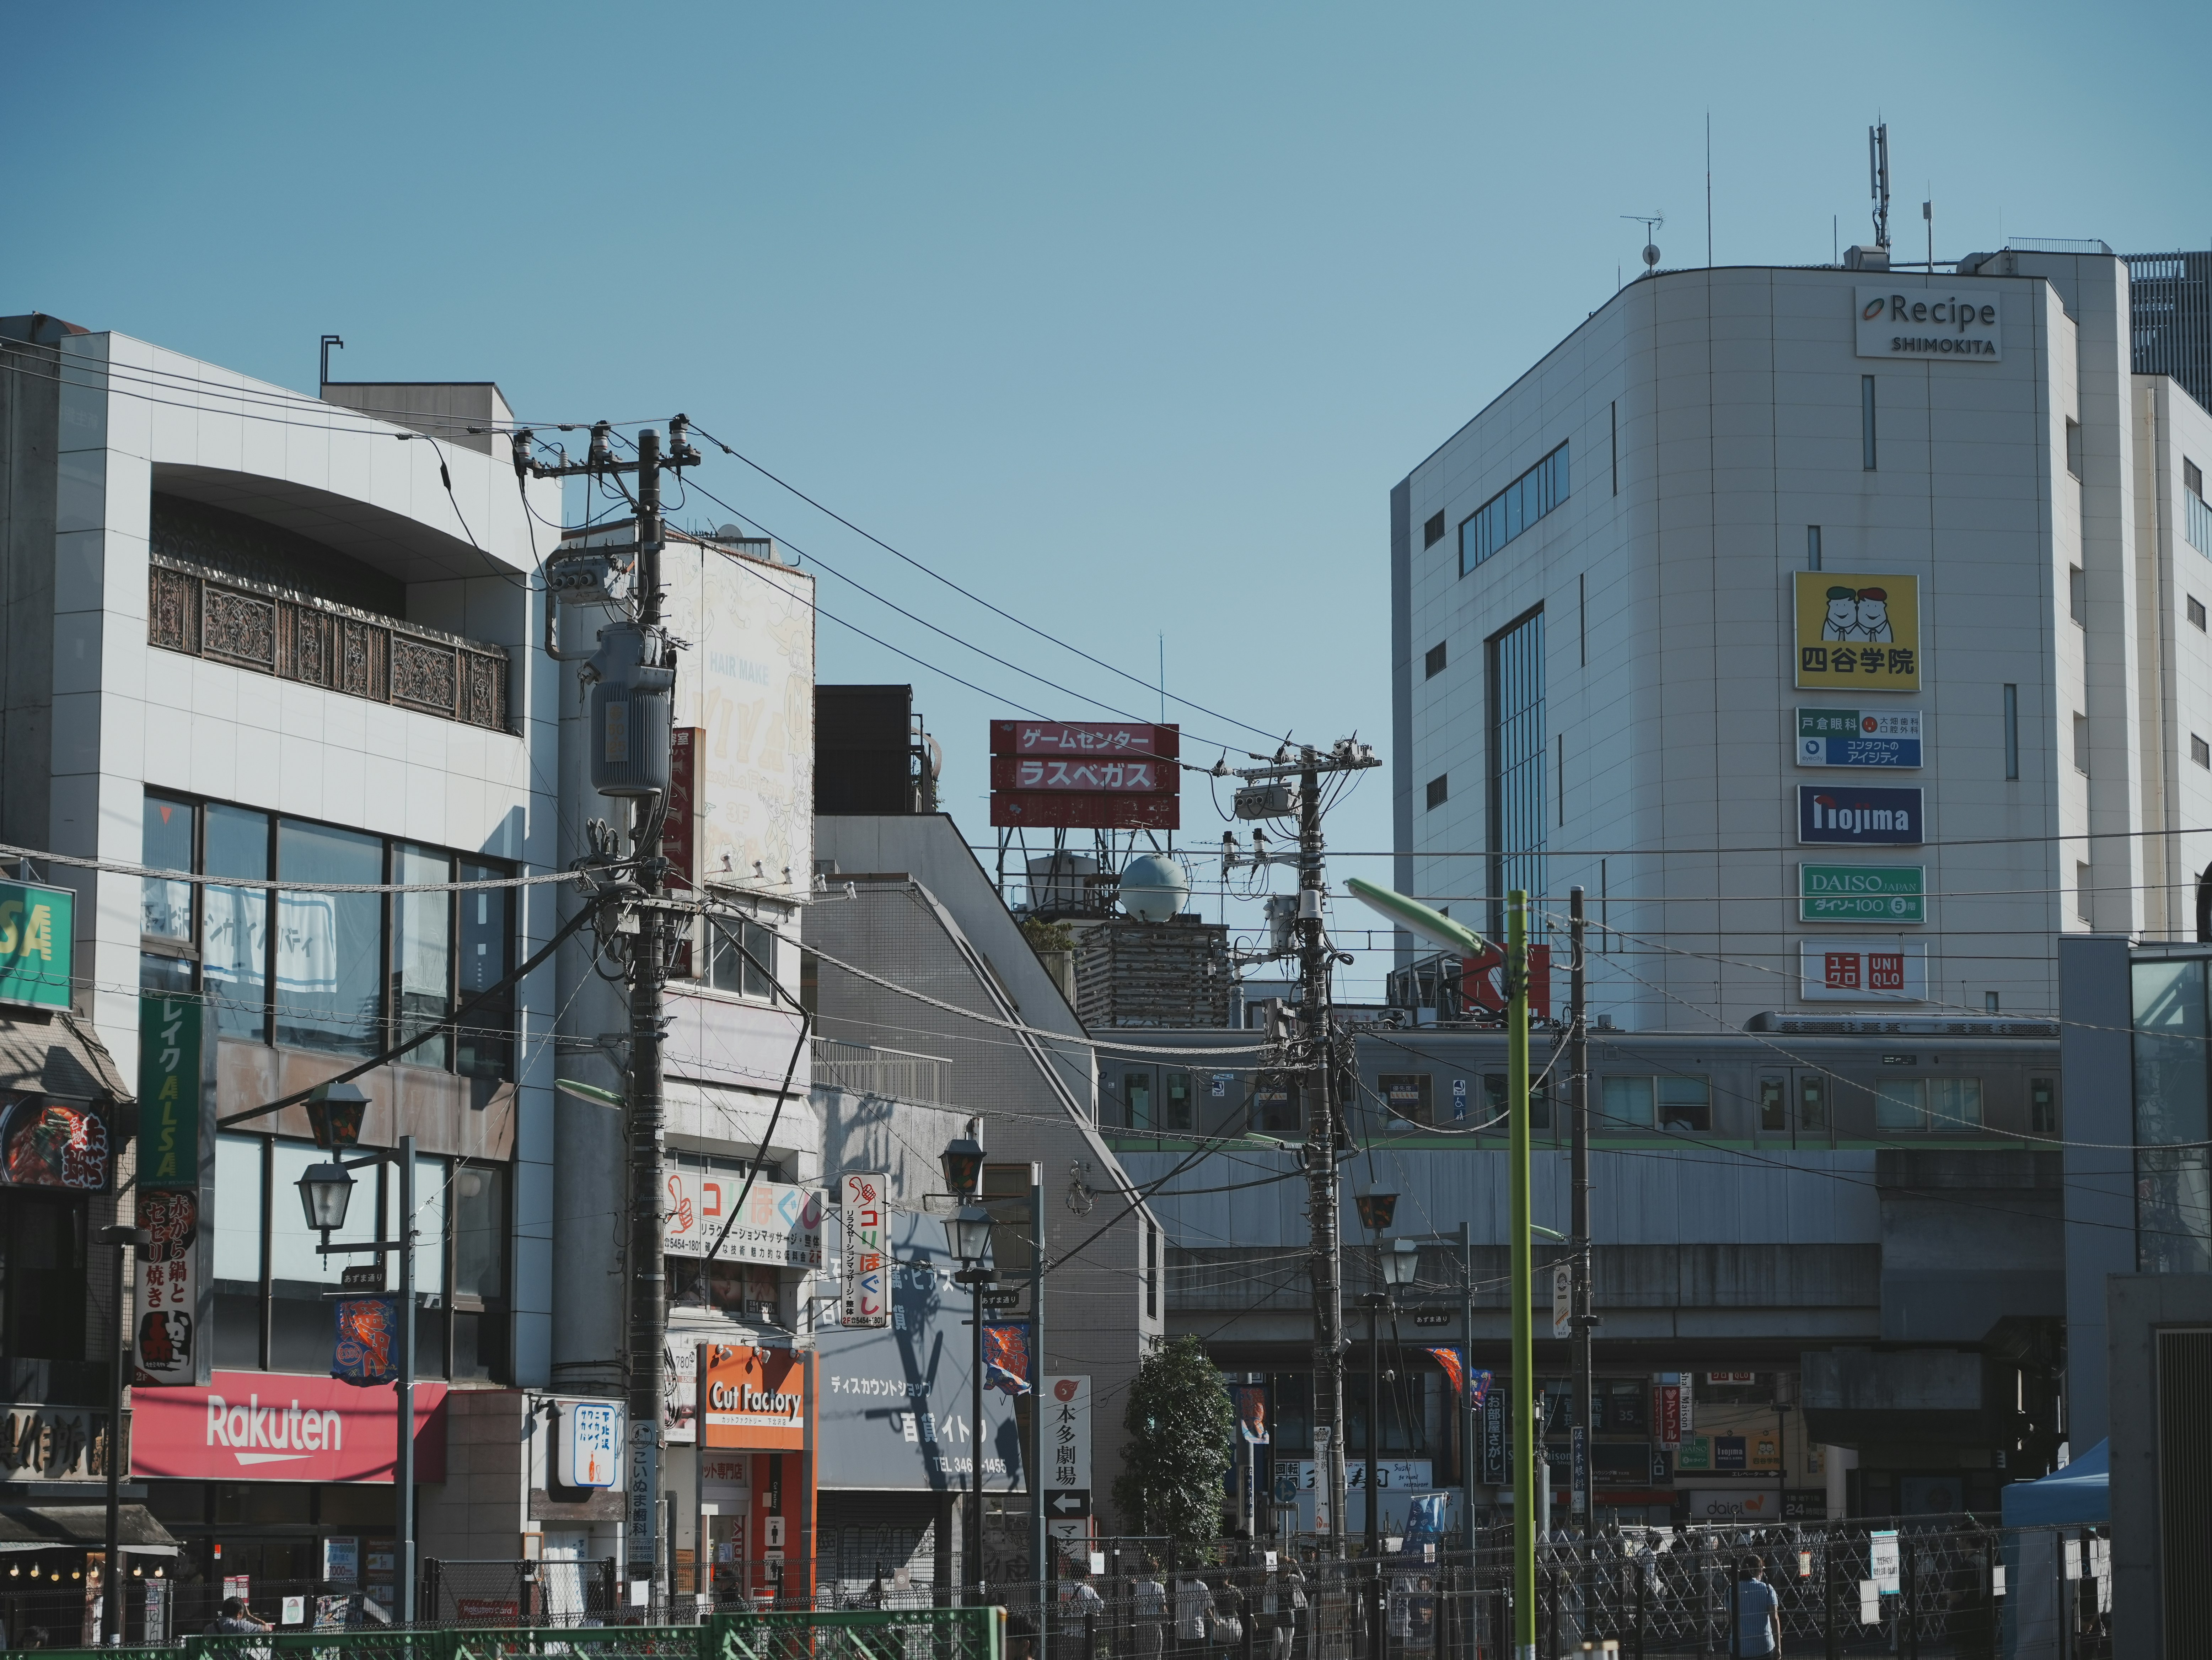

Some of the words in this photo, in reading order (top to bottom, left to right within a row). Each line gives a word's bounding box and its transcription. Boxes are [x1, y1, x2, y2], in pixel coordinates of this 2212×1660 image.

[1891, 295, 1995, 332] Recipe
[1892, 337, 1996, 354] SHIMOKITA
[710, 651, 737, 677] HAIR
[740, 657, 769, 686] MAKE
[1802, 647, 1914, 674] 四谷学院
[1802, 717, 1857, 731] 戸倉眼科
[1880, 717, 1918, 726] 大畑歯科
[1880, 726, 1918, 734] 口腔外科
[1022, 728, 1149, 750] ゲームセンター
[1848, 741, 1899, 750] コンタクトの
[1848, 751, 1899, 764] アイシティ
[1021, 761, 1151, 787] ラスベガス
[727, 802, 750, 825] 3F
[1814, 794, 1909, 834] nojima
[1812, 874, 1882, 891] DAISO
[1883, 883, 1916, 892] JAPAN
[1830, 957, 1856, 969] ユニ
[1873, 958, 1897, 970] UNI
[1830, 972, 1856, 985] クロ
[1873, 973, 1900, 987] QLO
[70, 1116, 82, 1144] 名物
[703, 1182, 821, 1230] コリほぐし
[146, 1203, 166, 1308] セセリ焼き
[168, 1195, 189, 1303] 赤から鍋と
[705, 1241, 745, 1256] 確な技術
[860, 1211, 880, 1315] コリほぐし
[344, 1273, 382, 1283] あずま通り
[982, 1295, 1016, 1304] あずま通り
[856, 1316, 883, 1325] 5454-1801
[136, 1372, 148, 1381] 2F
[831, 1375, 931, 1398] ディスカウントショップ
[709, 1381, 739, 1409] Cut
[741, 1384, 801, 1422] Factory
[207, 1394, 342, 1451] Rakuten
[722, 1416, 762, 1425] カットファクトリー
[768, 1418, 786, 1426] 下北沢店
[1619, 1410, 1634, 1422] 35
[1666, 1400, 1677, 1440] アイフル
[602, 1412, 610, 1451] 下北沢
[1487, 1396, 1501, 1471] お部屋さがし
[1056, 1404, 1077, 1486] 本多劇場
[933, 1456, 952, 1473] TEL
[955, 1457, 1007, 1474] 346-1455
[1546, 1451, 1572, 1461] aison
[1574, 1430, 1584, 1490] 佐々木眼科
[1654, 1452, 1665, 1476] 入口
[702, 1463, 743, 1480] ット専門店
[1275, 1463, 1298, 1475] 回転
[1394, 1464, 1411, 1472] Sushi
[633, 1451, 648, 1536] こいぬま歯科
[1707, 1500, 1744, 1515] daiei
[464, 1606, 494, 1614] Rakuten
[495, 1606, 512, 1615] Card
